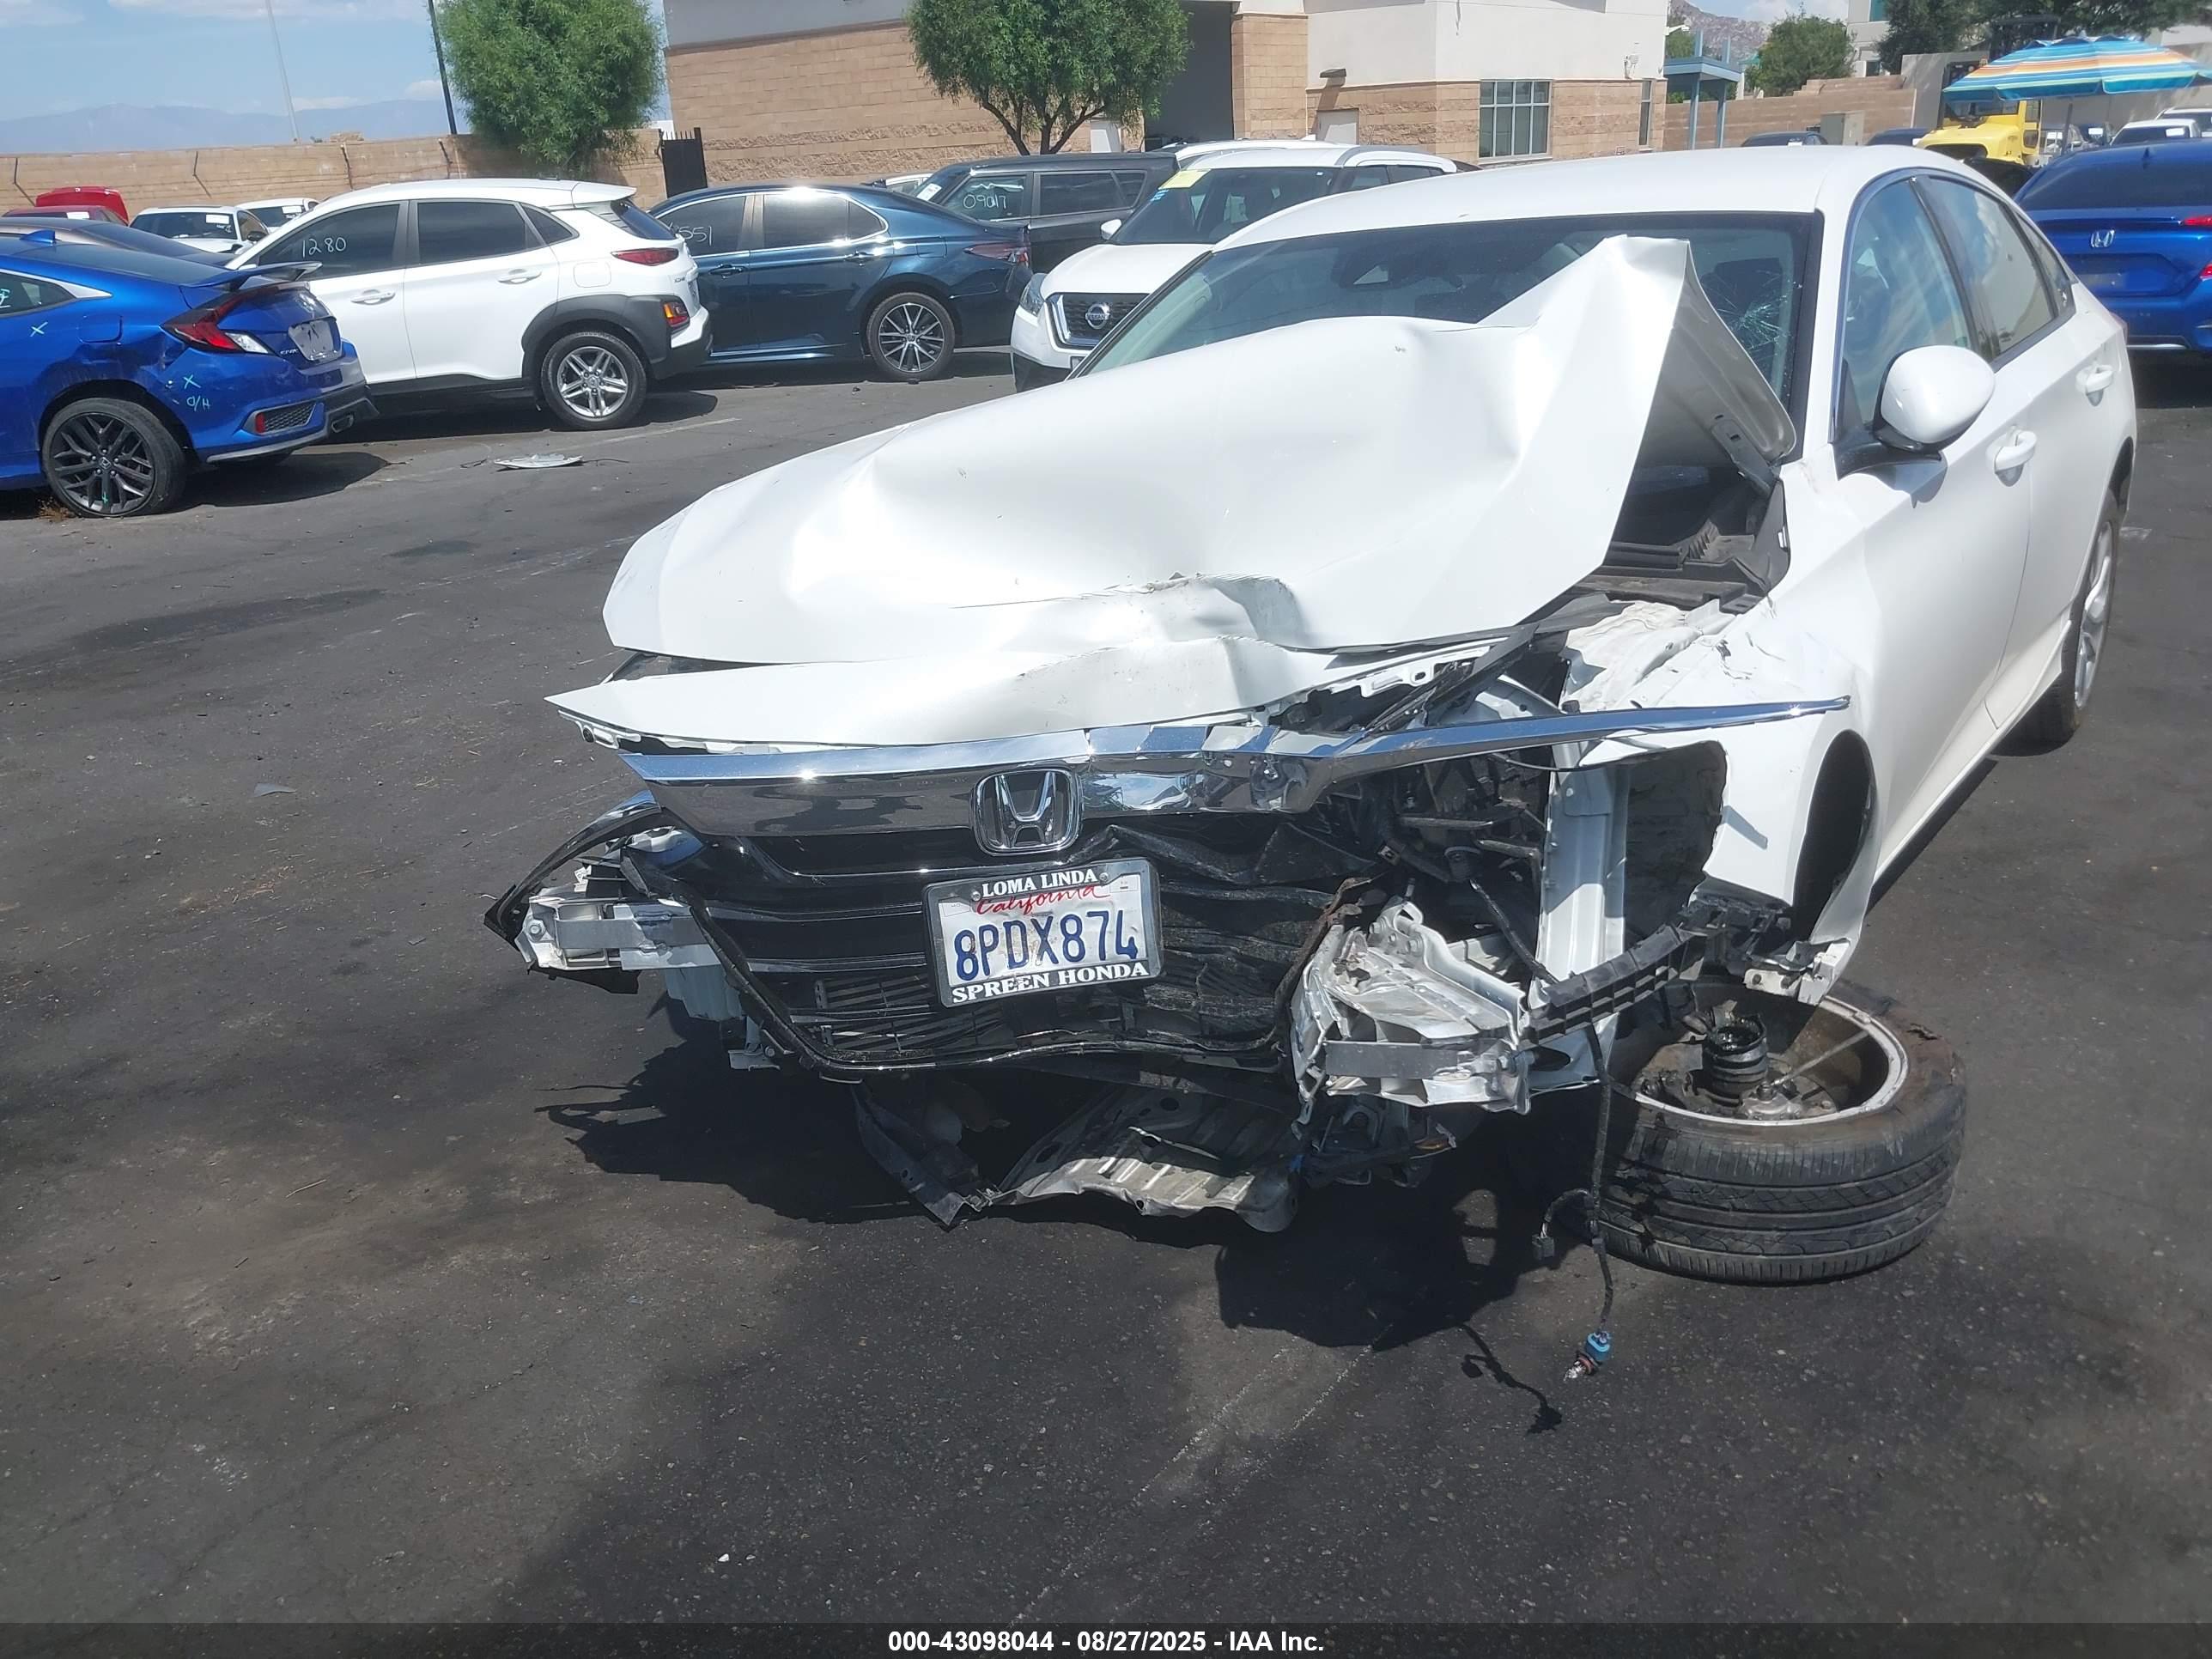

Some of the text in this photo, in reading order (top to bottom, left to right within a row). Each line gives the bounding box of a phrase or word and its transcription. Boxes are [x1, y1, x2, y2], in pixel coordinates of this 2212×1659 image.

[302, 237, 346, 258] 1280
[981, 868, 1097, 897] LOMA LINDA
[976, 885, 1110, 915] California
[954, 910, 1138, 981] 8PDX874
[951, 962, 1148, 1004] SPREEN HONDA
